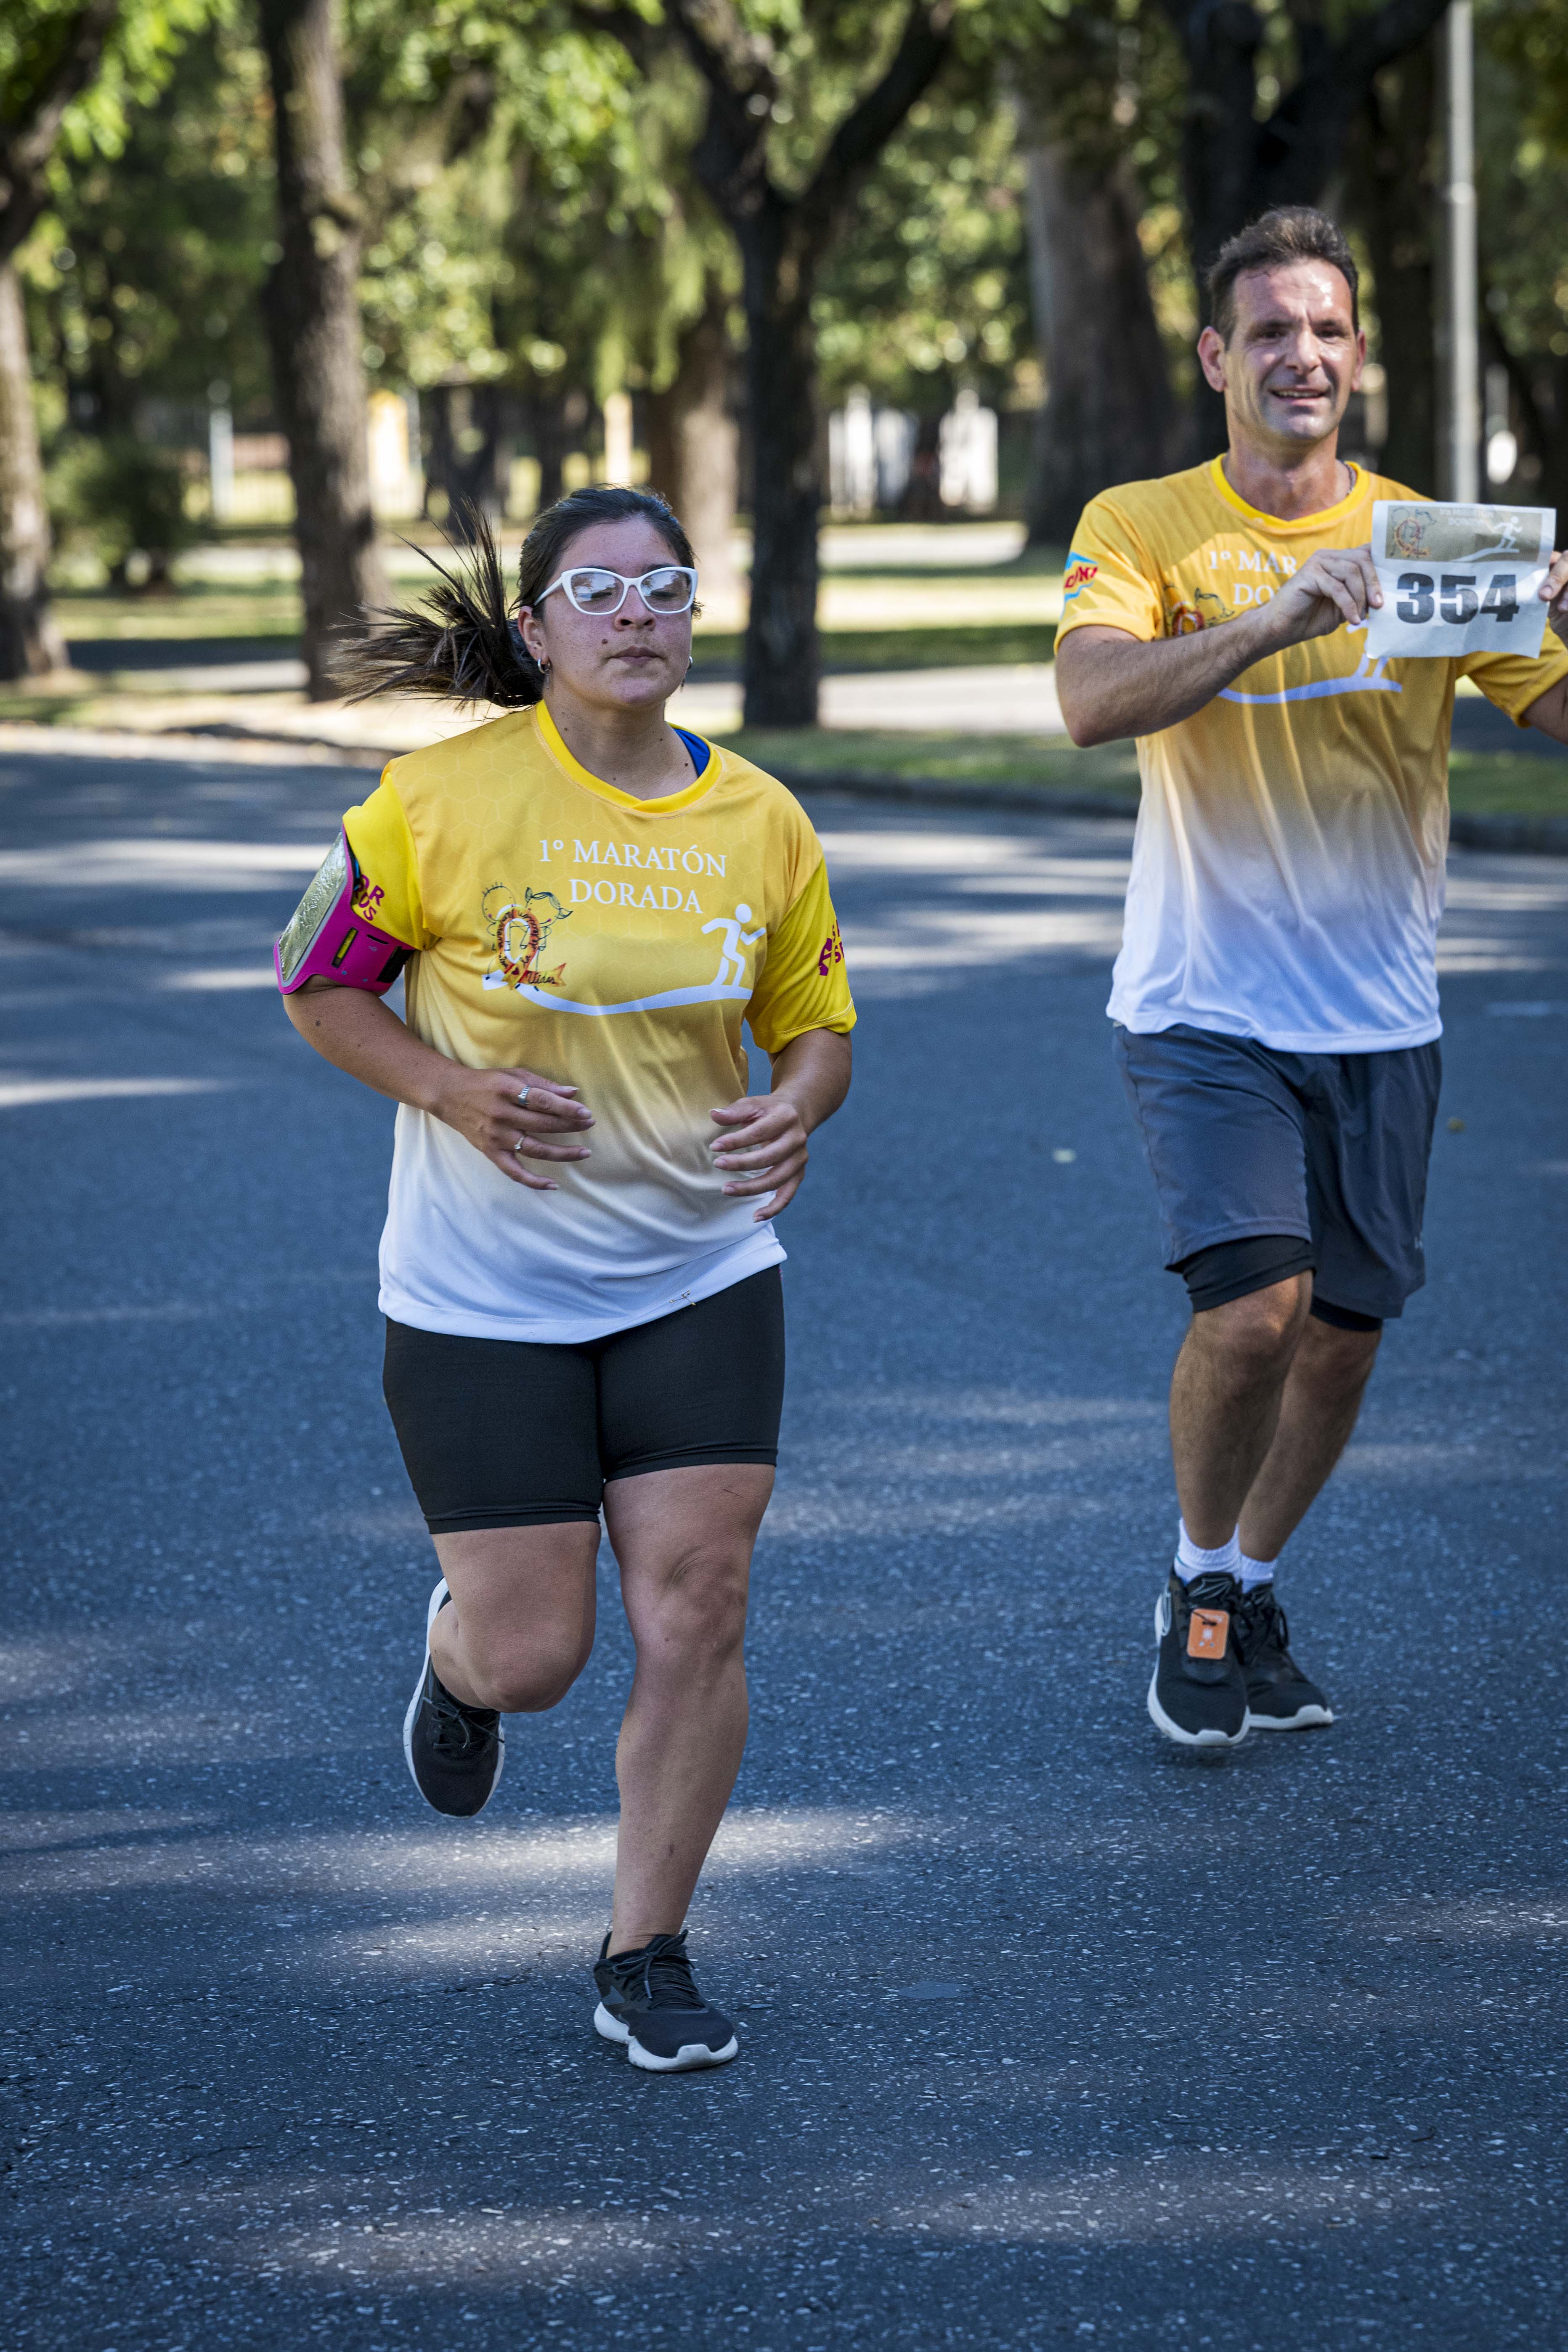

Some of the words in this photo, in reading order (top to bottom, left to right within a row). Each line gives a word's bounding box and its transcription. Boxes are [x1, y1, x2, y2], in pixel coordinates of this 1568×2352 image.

[1233, 583, 1279, 605] DO
[1396, 573, 1520, 624] 354
[539, 839, 564, 862] 1º
[573, 840, 727, 878] MARATÓN
[569, 879, 703, 914] DORADA
